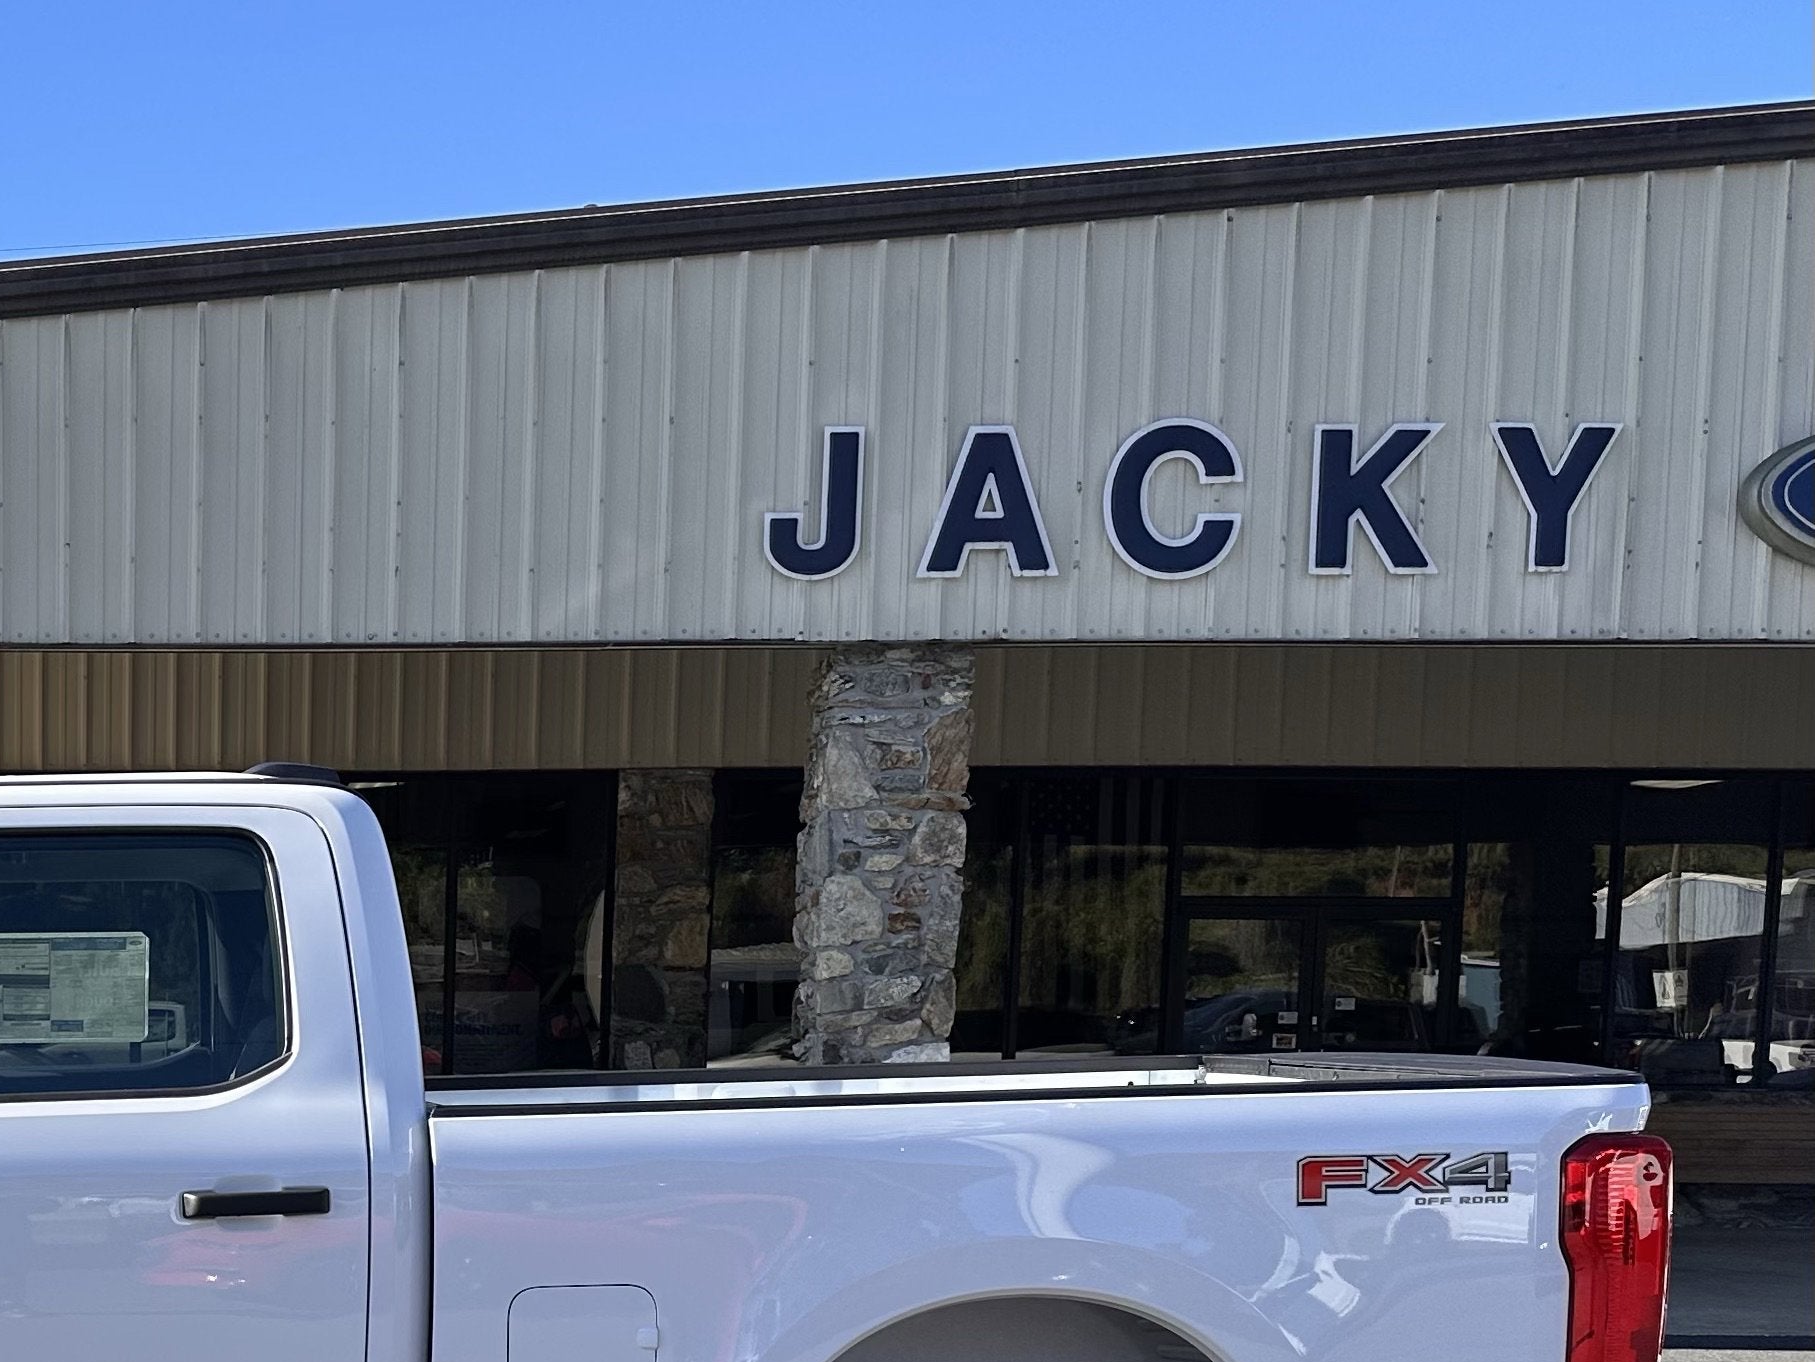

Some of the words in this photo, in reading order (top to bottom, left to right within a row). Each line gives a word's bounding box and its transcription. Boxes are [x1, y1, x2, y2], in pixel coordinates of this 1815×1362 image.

[764, 418, 1623, 580] JACKY
[1297, 1151, 1511, 1206] FX4
[1414, 1196, 1453, 1206] OFF
[1459, 1195, 1509, 1204] ROAD
